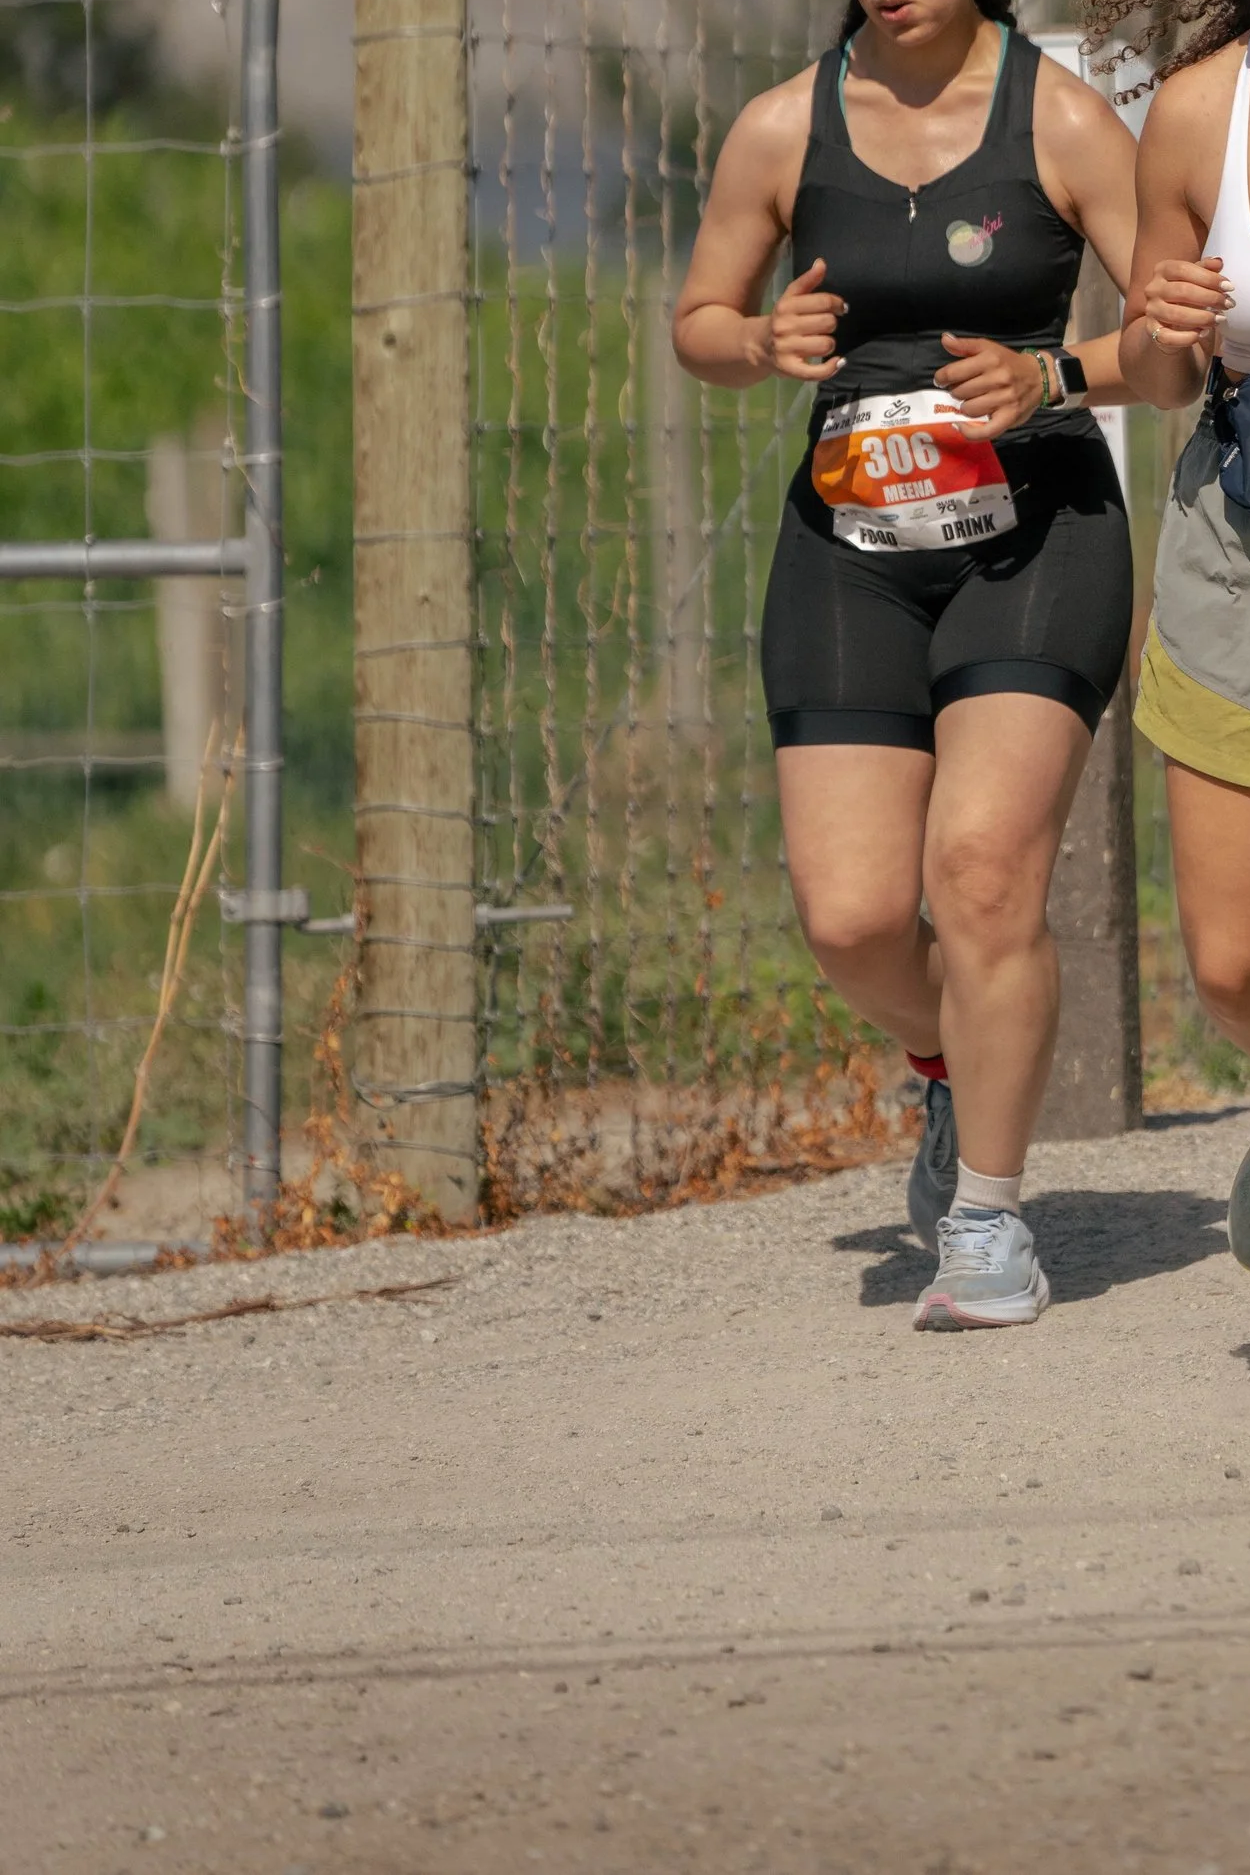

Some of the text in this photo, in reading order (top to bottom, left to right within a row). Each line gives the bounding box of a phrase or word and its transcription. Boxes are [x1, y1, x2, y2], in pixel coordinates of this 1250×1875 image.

[852, 411, 872, 425] 2025
[861, 431, 941, 480] 306
[882, 479, 936, 504] MEENA
[937, 504, 957, 514] 70
[859, 527, 898, 547] FOOD
[941, 513, 997, 542] DRINK
